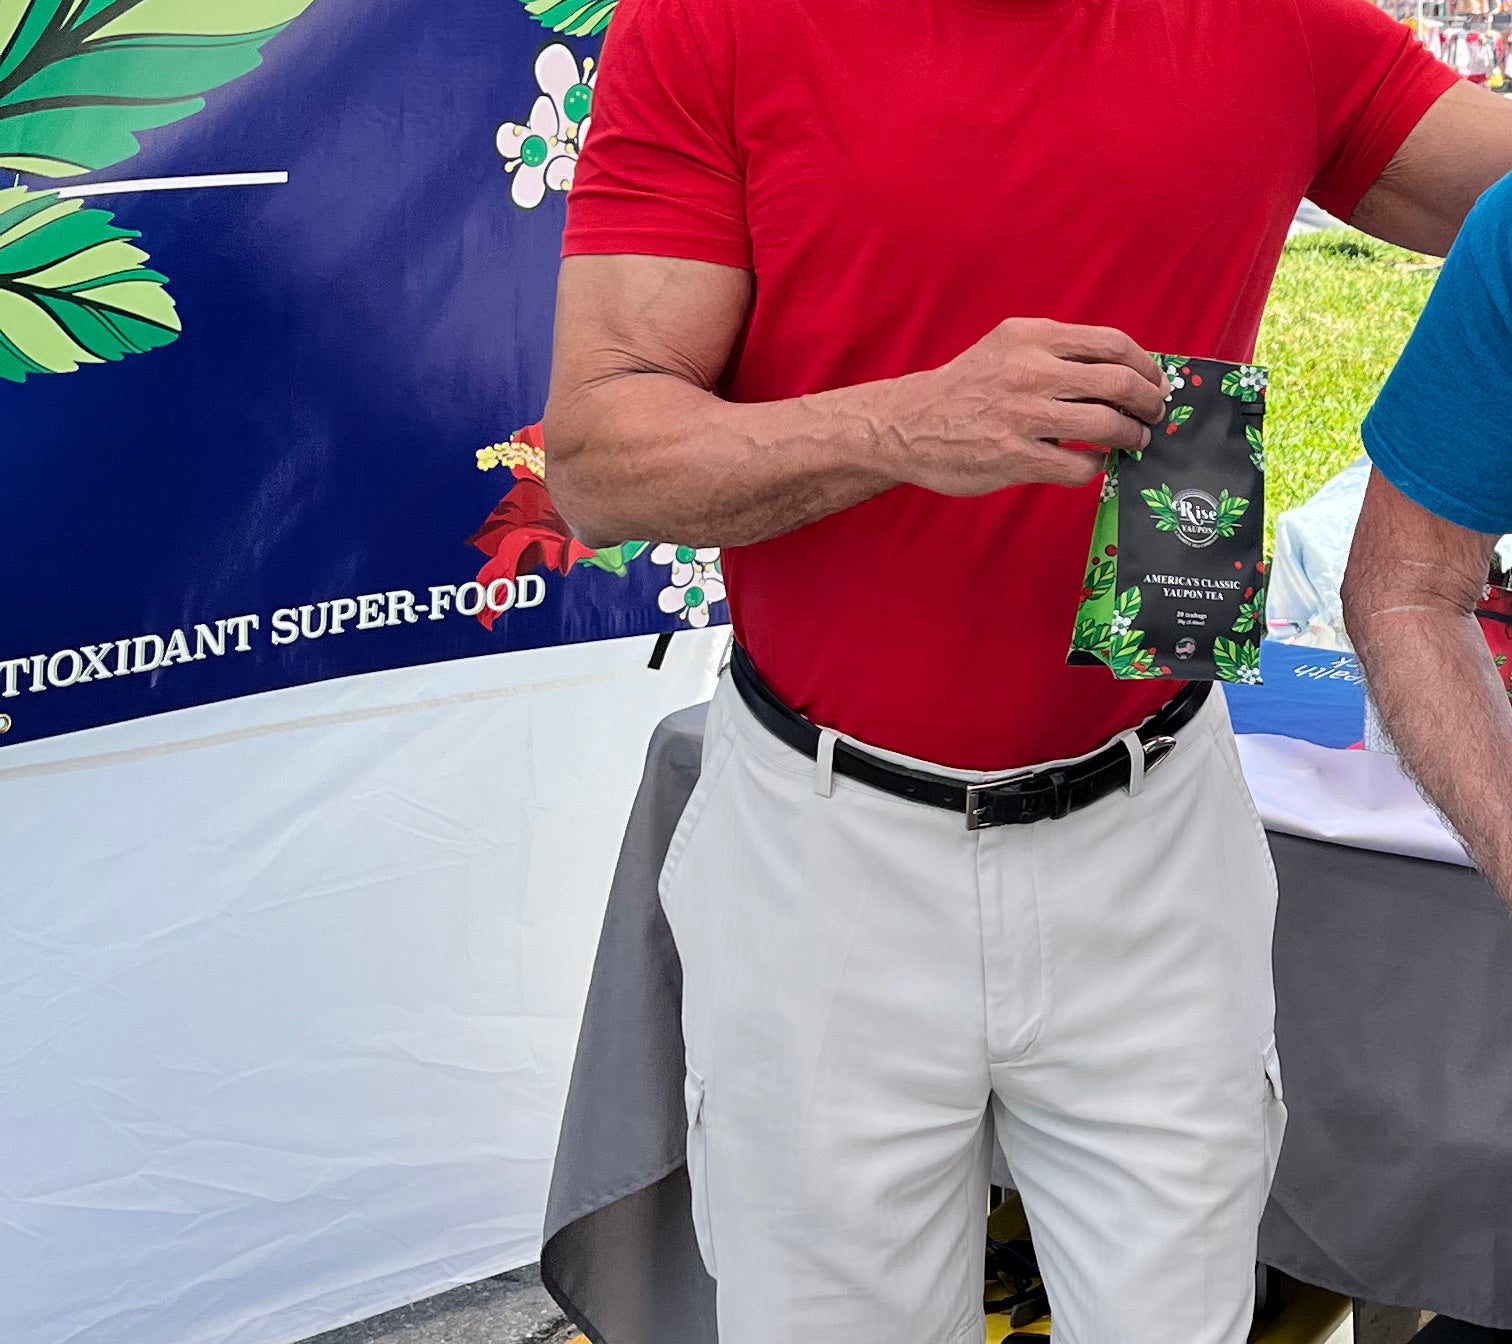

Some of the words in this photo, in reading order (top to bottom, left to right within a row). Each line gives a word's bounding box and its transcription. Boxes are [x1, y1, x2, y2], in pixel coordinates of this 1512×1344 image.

[1171, 500, 1217, 526] Rise
[1181, 524, 1214, 534] YAUPON
[1143, 573, 1200, 587] AMERICA'S
[1200, 578, 1241, 590] CLASSIC
[1162, 587, 1203, 600] YAUPON
[1204, 591, 1224, 601] TEA
[271, 574, 546, 645] SUPER-FOOD
